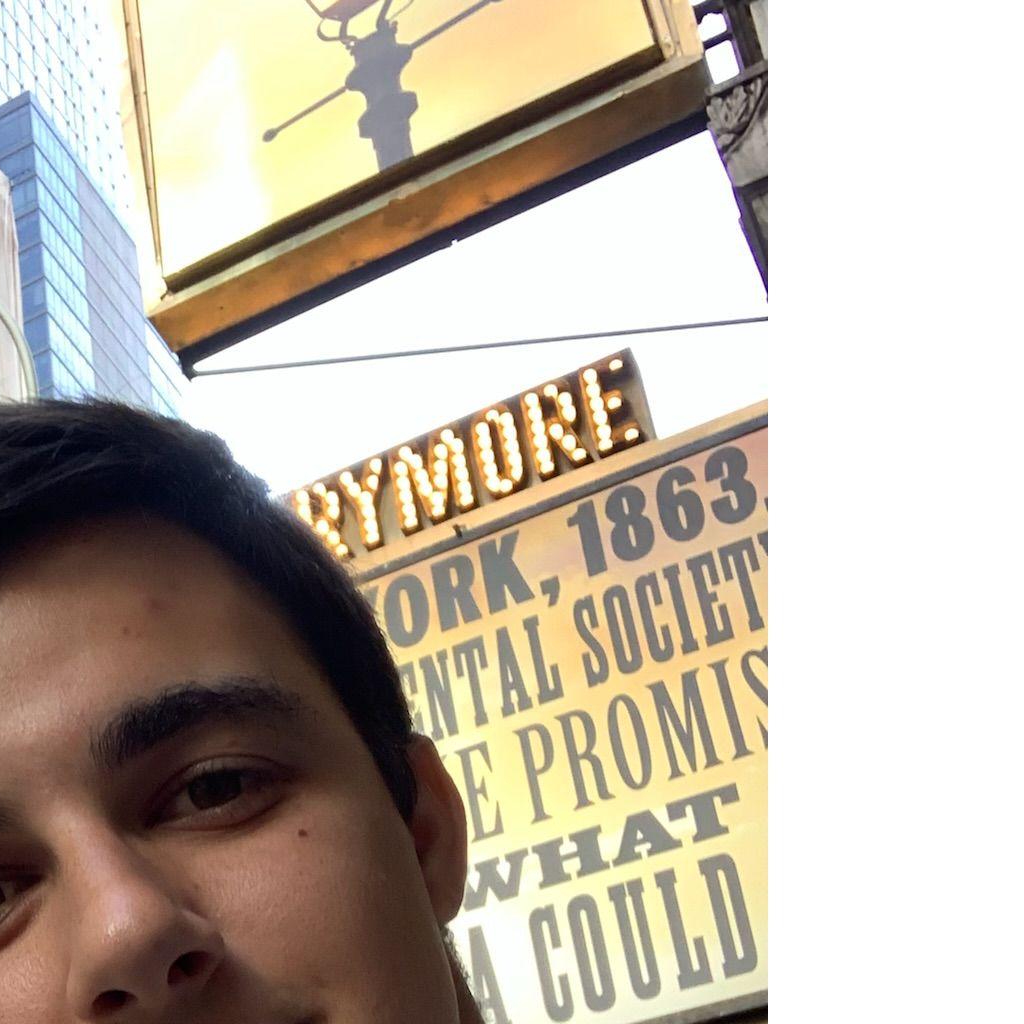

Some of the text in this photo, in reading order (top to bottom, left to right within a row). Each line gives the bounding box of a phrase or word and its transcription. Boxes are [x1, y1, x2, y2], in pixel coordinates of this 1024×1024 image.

[364, 446, 768, 649] ORK, 1863
[573, 528, 768, 688] SOCIET
[463, 783, 740, 912] WHAT
[528, 852, 758, 1024] COULD
